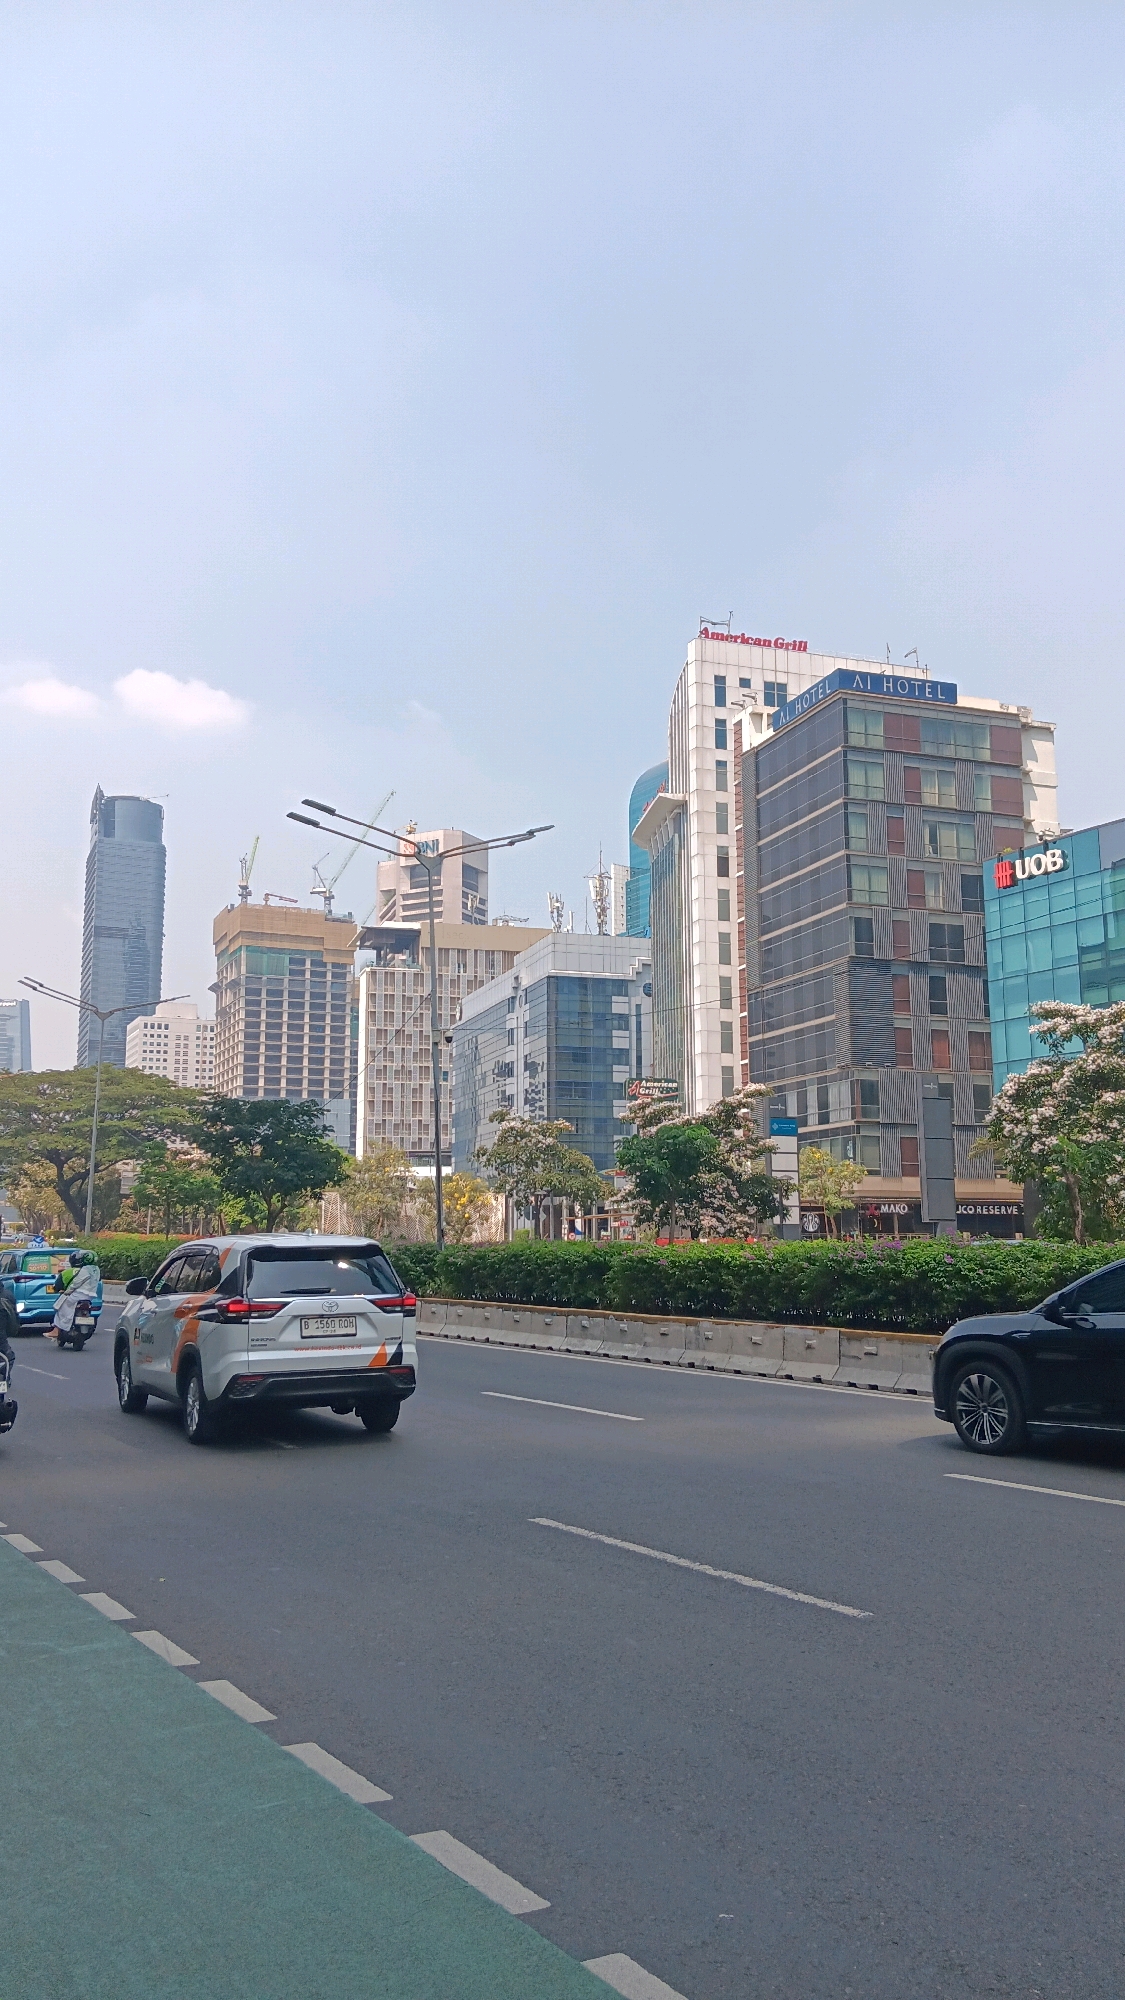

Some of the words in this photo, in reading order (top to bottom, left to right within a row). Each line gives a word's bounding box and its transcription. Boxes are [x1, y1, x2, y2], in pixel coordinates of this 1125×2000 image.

[700, 627, 771, 648] American
[774, 637, 808, 652] Grill
[883, 677, 946, 699] HOTEL
[795, 680, 831, 712] HOTEL
[1015, 849, 1065, 880] UOB
[640, 1080, 678, 1088] American
[640, 1087, 659, 1095] Grill
[880, 1203, 909, 1215] MAKO
[976, 1205, 1019, 1215] RESERVE
[303, 1320, 310, 1330] B
[314, 1319, 336, 1330] 1560
